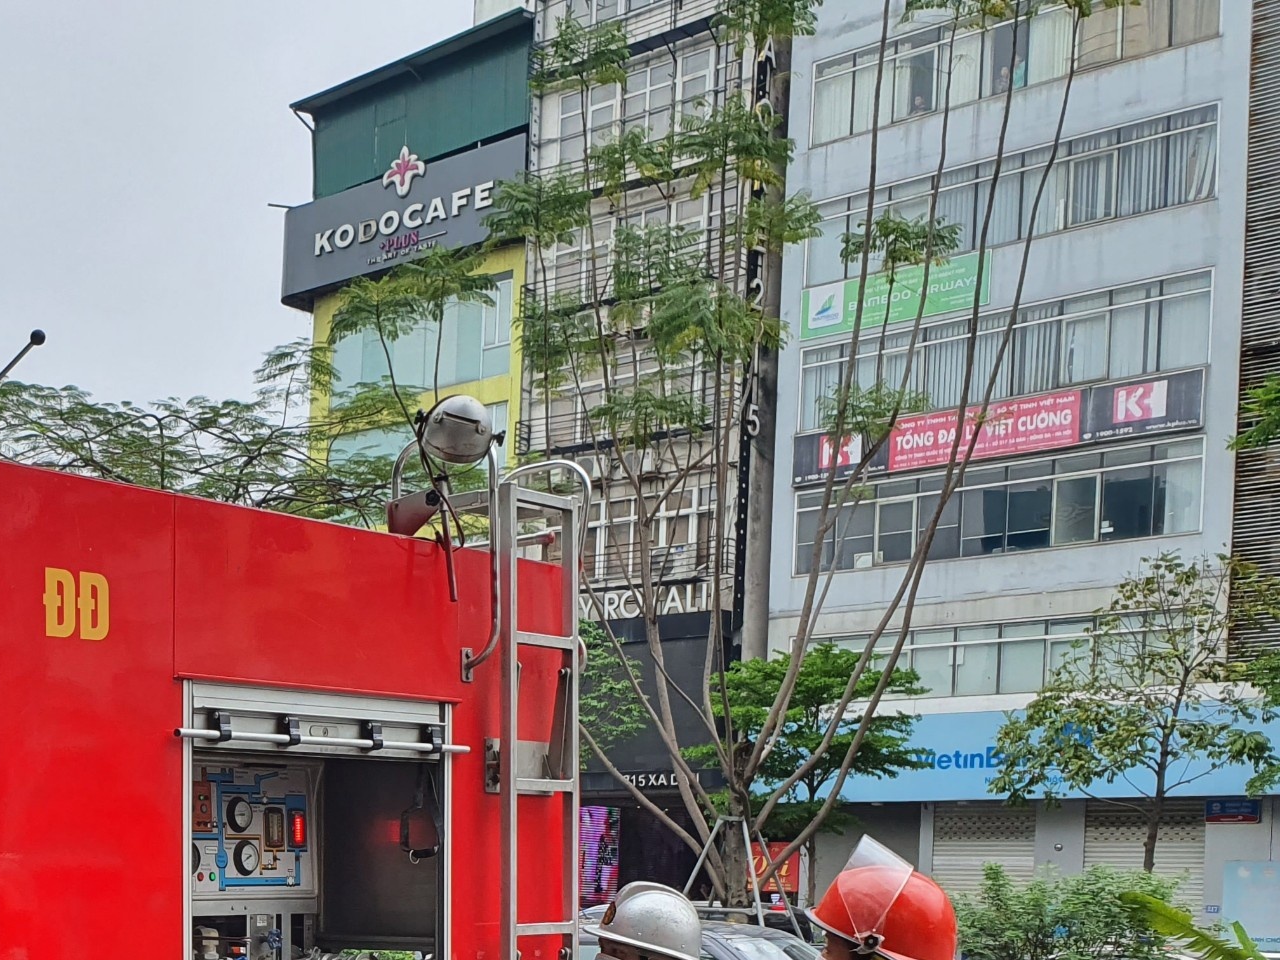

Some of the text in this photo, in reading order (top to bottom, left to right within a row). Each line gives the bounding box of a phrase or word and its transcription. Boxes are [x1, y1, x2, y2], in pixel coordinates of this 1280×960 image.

[314, 180, 495, 256] KODOCAFE
[382, 251, 398, 261] ART
[937, 427, 957, 445] ĐẠ
[1018, 408, 1073, 432] CƯỜNG
[43, 567, 110, 641] ĐĐ
[648, 773, 668, 786] XA
